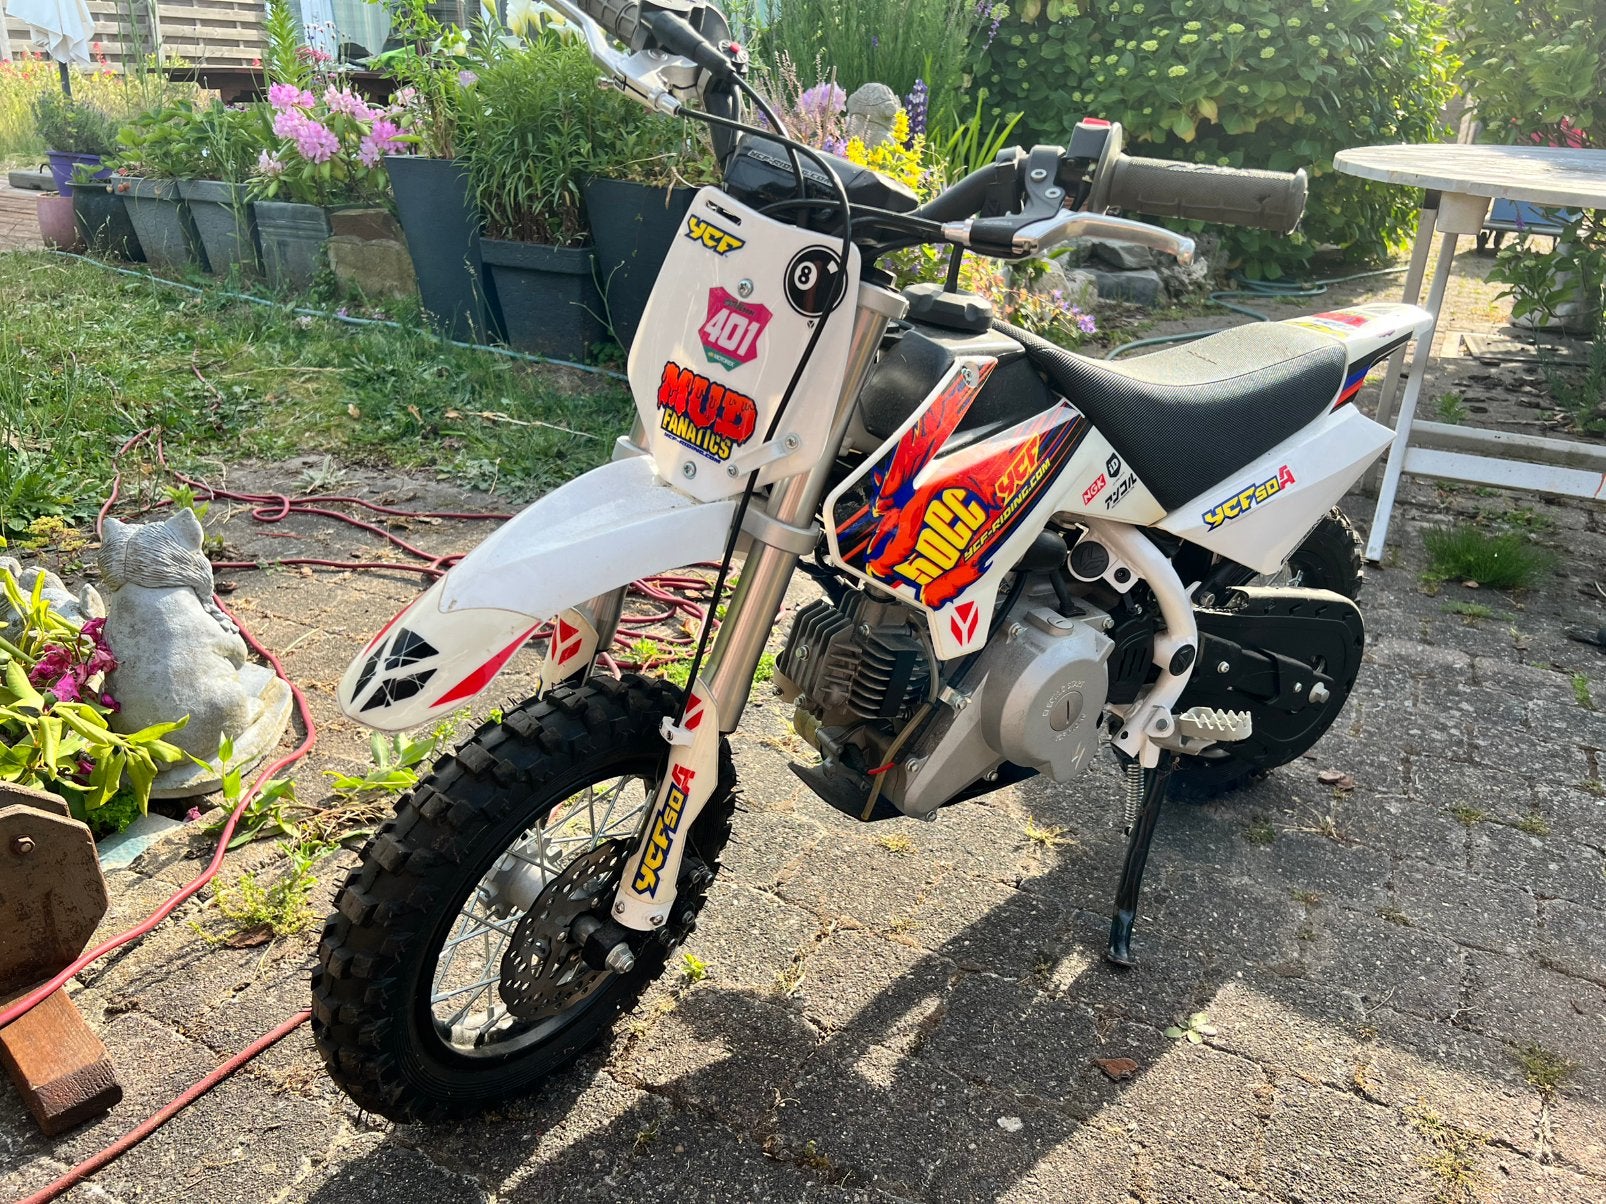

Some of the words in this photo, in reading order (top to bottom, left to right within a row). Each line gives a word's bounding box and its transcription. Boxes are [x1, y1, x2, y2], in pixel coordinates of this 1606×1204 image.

[685, 214, 746, 256] YCF
[798, 265, 813, 285] 8
[703, 307, 761, 357] 401
[657, 361, 758, 447] MUD
[661, 408, 732, 460] FANATICS
[995, 431, 1040, 507] YCF
[1082, 474, 1106, 505] NGK
[963, 456, 1051, 562] YCF-RIDING.COM
